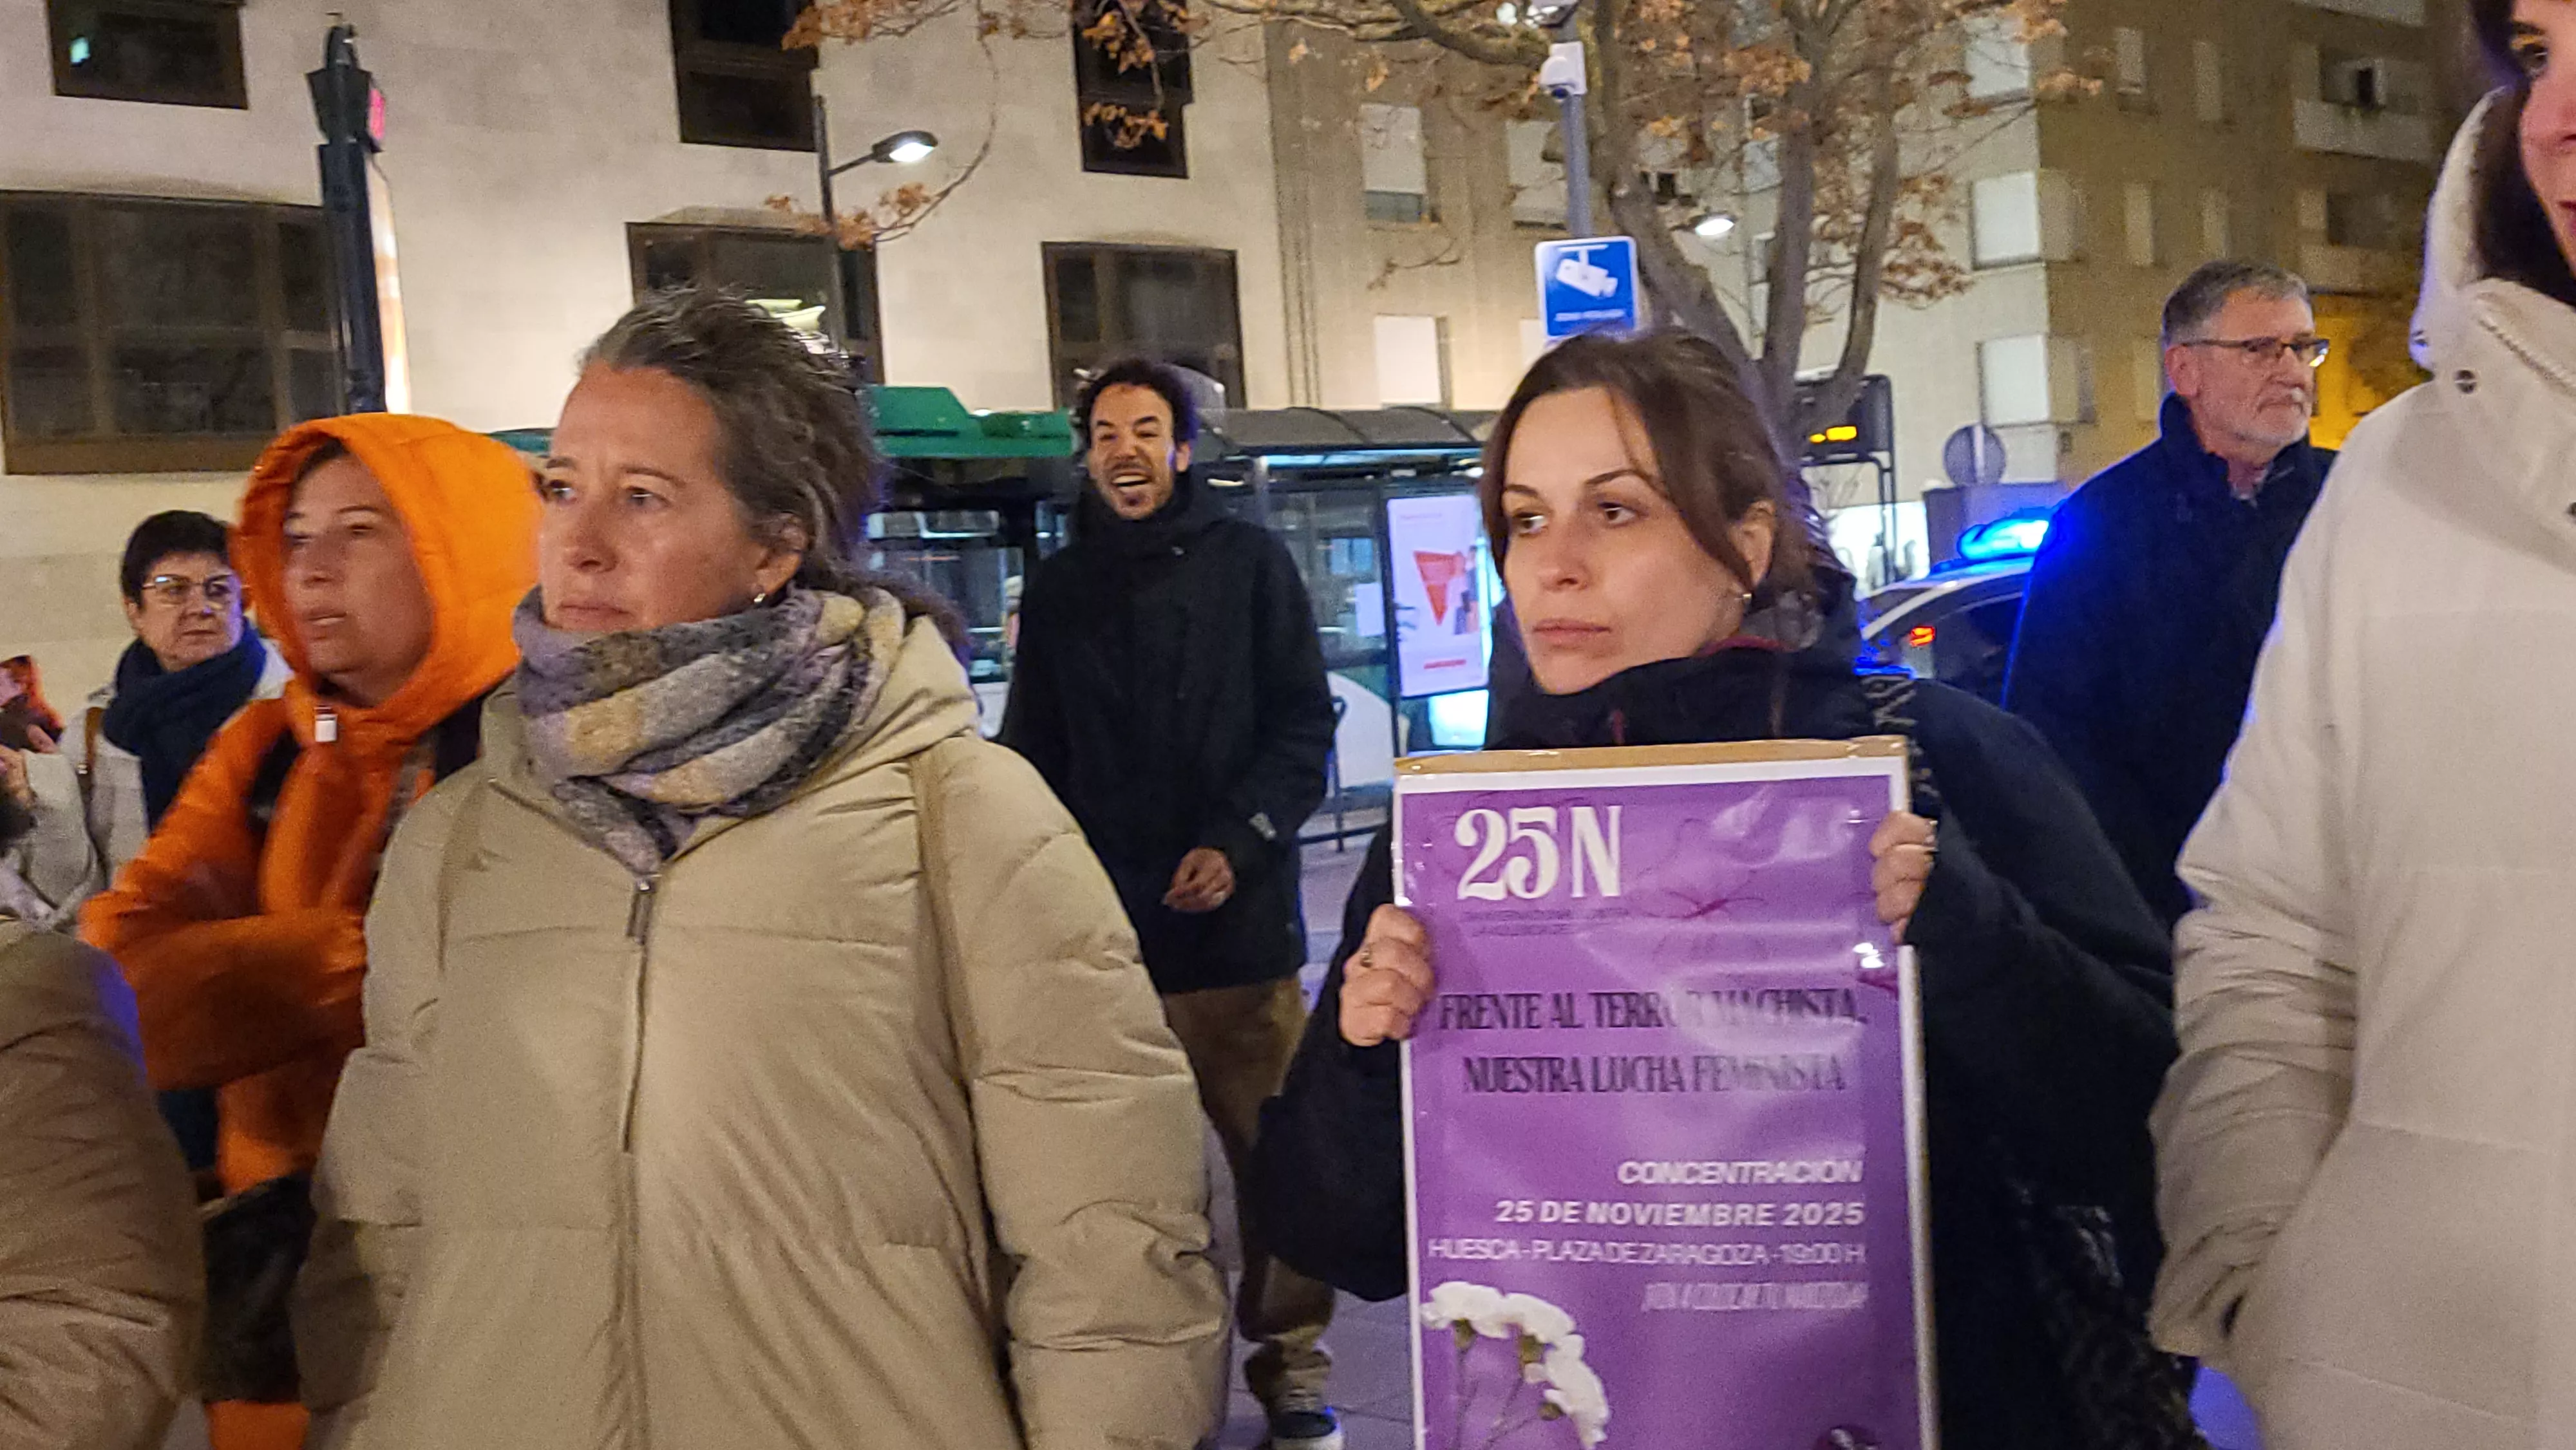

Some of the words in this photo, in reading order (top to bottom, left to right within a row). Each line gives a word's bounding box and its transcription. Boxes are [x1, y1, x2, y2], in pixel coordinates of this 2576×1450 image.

[1439, 993, 1543, 1029] FRENTE
[1550, 992, 1585, 1029] AL
[1587, 992, 1706, 1028] TERR
[1463, 1056, 1586, 1093] NUESTRA
[1592, 1055, 1687, 1093] LUCHA
[1692, 1054, 1846, 1091] FEISTA
[1495, 1200, 1534, 1223] 25
[1539, 1200, 1582, 1223] DE
[1585, 1201, 1776, 1227] NOVIEMBRE
[1781, 1202, 1865, 1226] 2025
